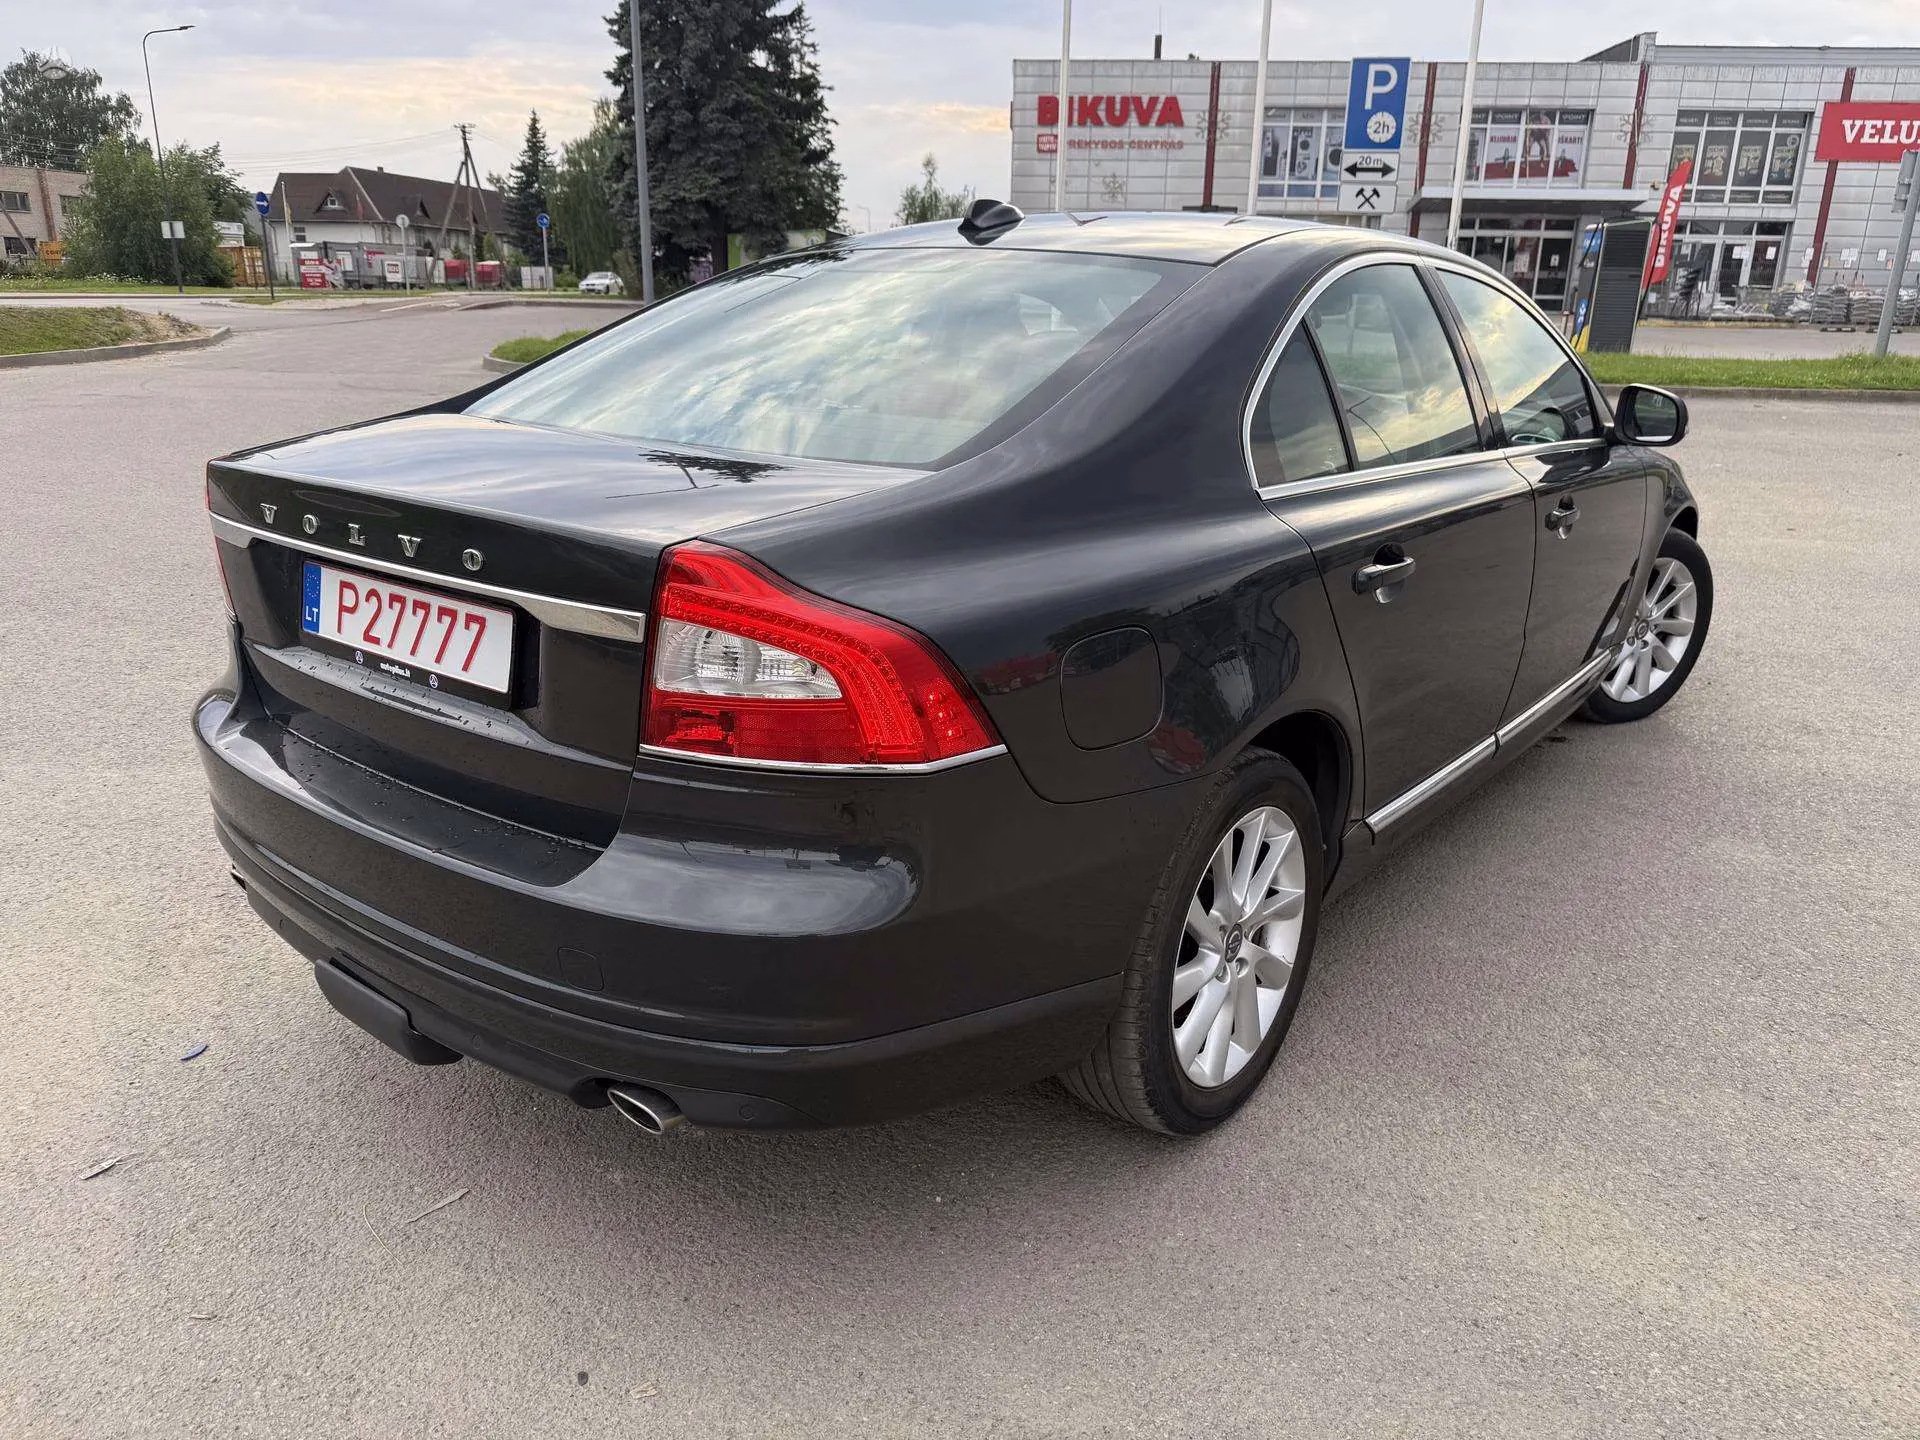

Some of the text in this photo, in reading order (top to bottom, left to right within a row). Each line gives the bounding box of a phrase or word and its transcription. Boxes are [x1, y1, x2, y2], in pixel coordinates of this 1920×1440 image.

[1365, 64, 1398, 110] P
[1037, 95, 1184, 127] BIKUVA
[1129, 140, 1183, 150] CENTRAS
[1842, 120, 1920, 144] VELU
[260, 503, 484, 571] VOLVO
[305, 607, 319, 622] LT
[337, 580, 487, 672] P27777
